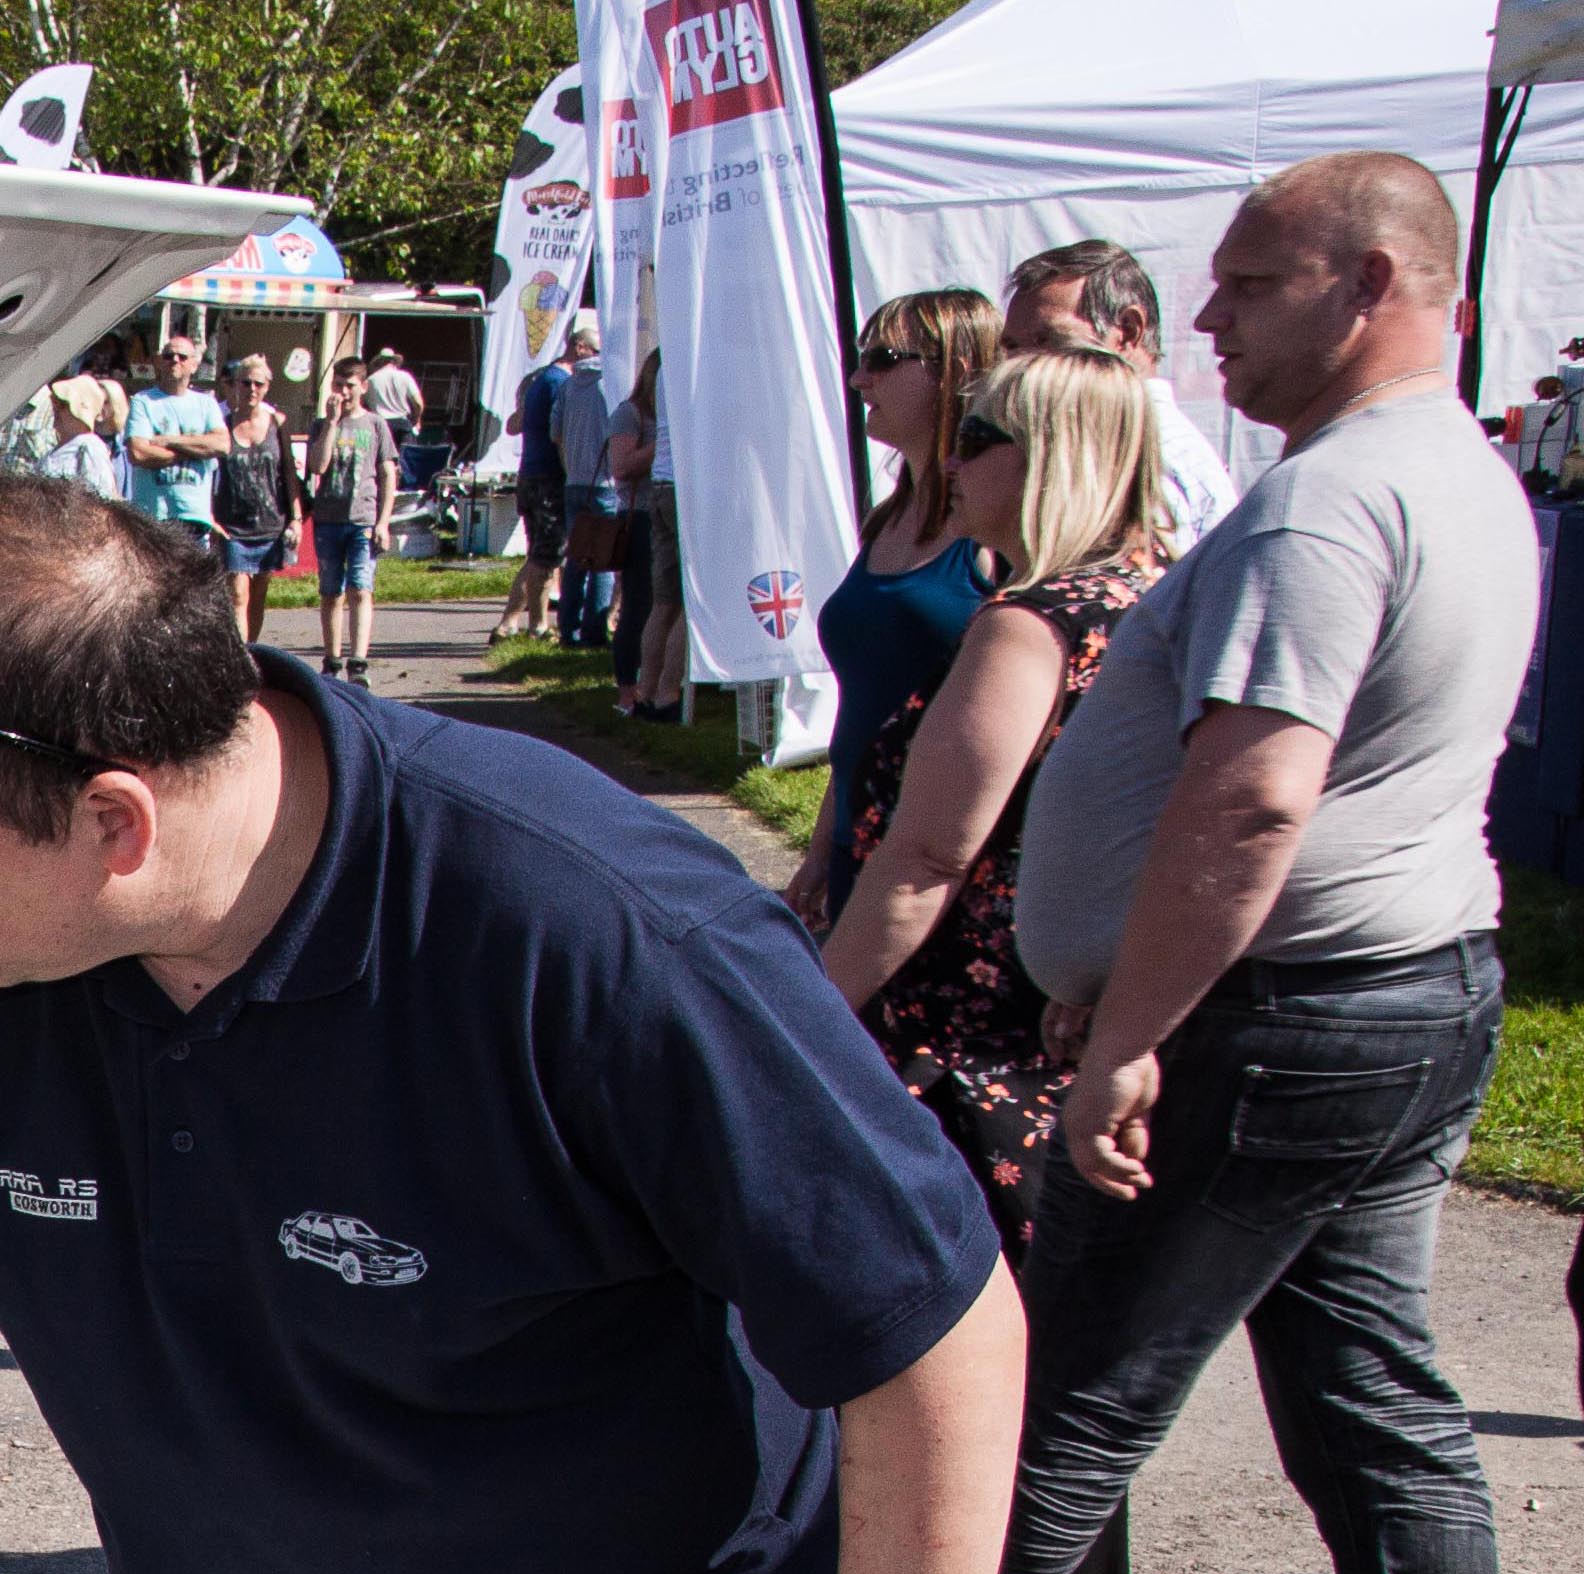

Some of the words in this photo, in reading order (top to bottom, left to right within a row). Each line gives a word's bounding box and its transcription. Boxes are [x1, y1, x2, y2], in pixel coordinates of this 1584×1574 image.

[523, 242, 540, 259] ICE
[58, 1179, 98, 1197] RS
[13, 1194, 93, 1217] COSWORTH
